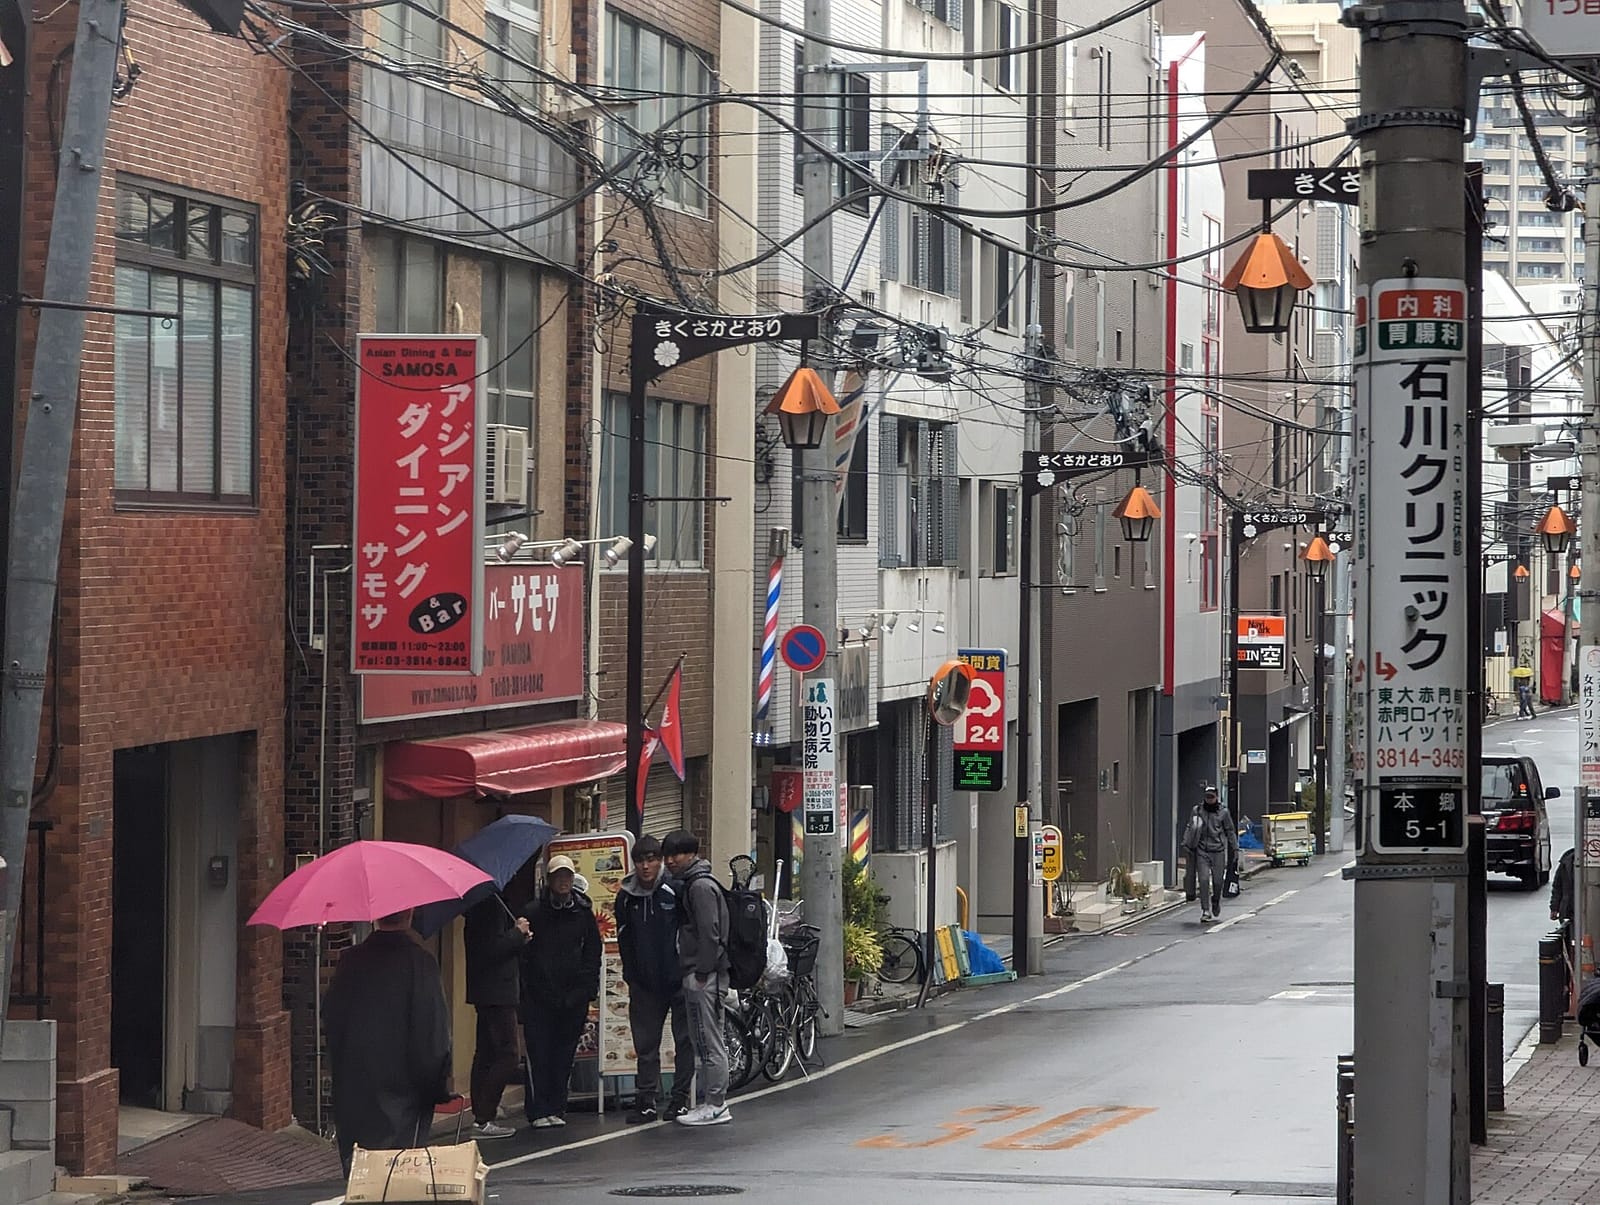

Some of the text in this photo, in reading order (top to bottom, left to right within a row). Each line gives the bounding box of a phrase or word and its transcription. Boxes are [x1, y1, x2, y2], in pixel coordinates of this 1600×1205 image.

[1294, 171, 1360, 194] きくさ
[1397, 294, 1452, 317] 内科
[654, 319, 782, 338] きくさかどおり
[1388, 322, 1458, 346] 胃腸科
[366, 348, 473, 358] Asian Dining & Bar
[382, 363, 458, 377] SAMOSA
[436, 383, 472, 537] アジアン
[1038, 454, 1123, 467] きくさかどおり
[394, 402, 432, 599] ダイニング
[1399, 360, 1450, 671] 石川クリニック
[361, 542, 389, 630] サモサ
[429, 597, 441, 608] &
[418, 600, 463, 632] Bar
[1260, 645, 1281, 666] 空
[1583, 673, 1595, 753] 女性クリニック
[804, 705, 818, 769] 動物病院
[819, 705, 834, 753] いりえ
[970, 725, 1000, 743] 24
[960, 752, 992, 785] 空
[1393, 792, 1456, 812] 本郷
[1405, 820, 1446, 838] 5-1
[1043, 847, 1056, 863] P
